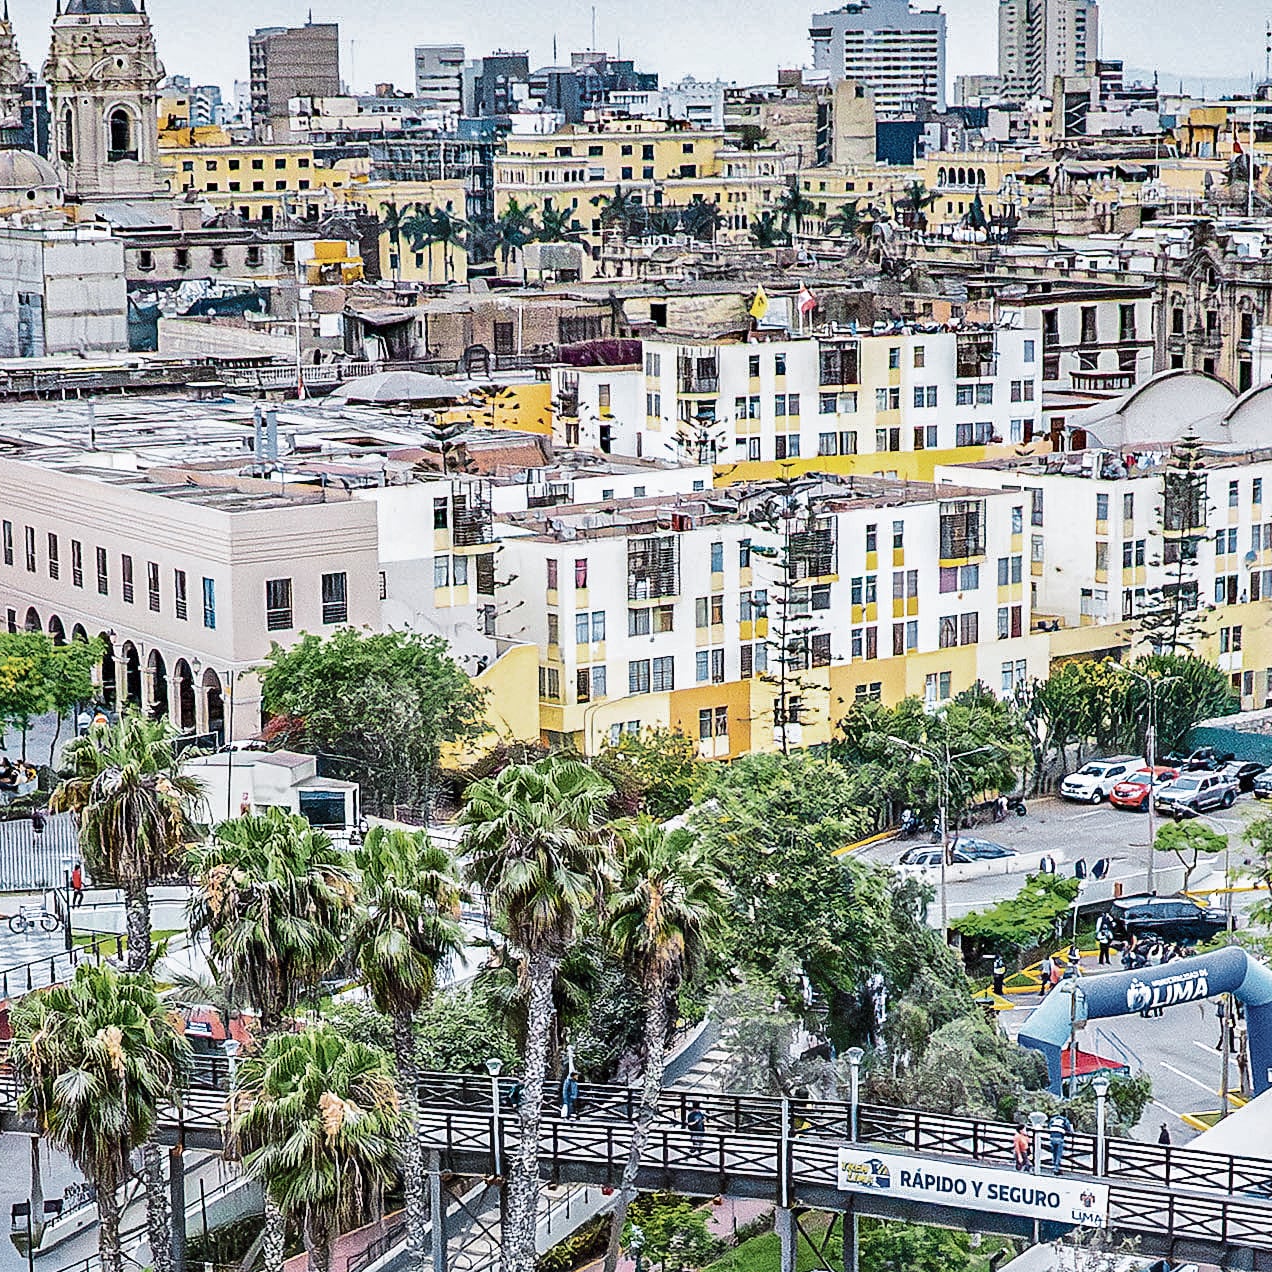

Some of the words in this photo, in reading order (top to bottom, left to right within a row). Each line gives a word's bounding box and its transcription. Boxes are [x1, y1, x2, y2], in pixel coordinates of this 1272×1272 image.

[1150, 977, 1208, 1008] LIMA
[900, 1168, 967, 1195] RÁPIDO
[971, 1180, 983, 1198] Y
[987, 1184, 1061, 1208] SEGURO
[1071, 1210, 1103, 1226] LIMA
